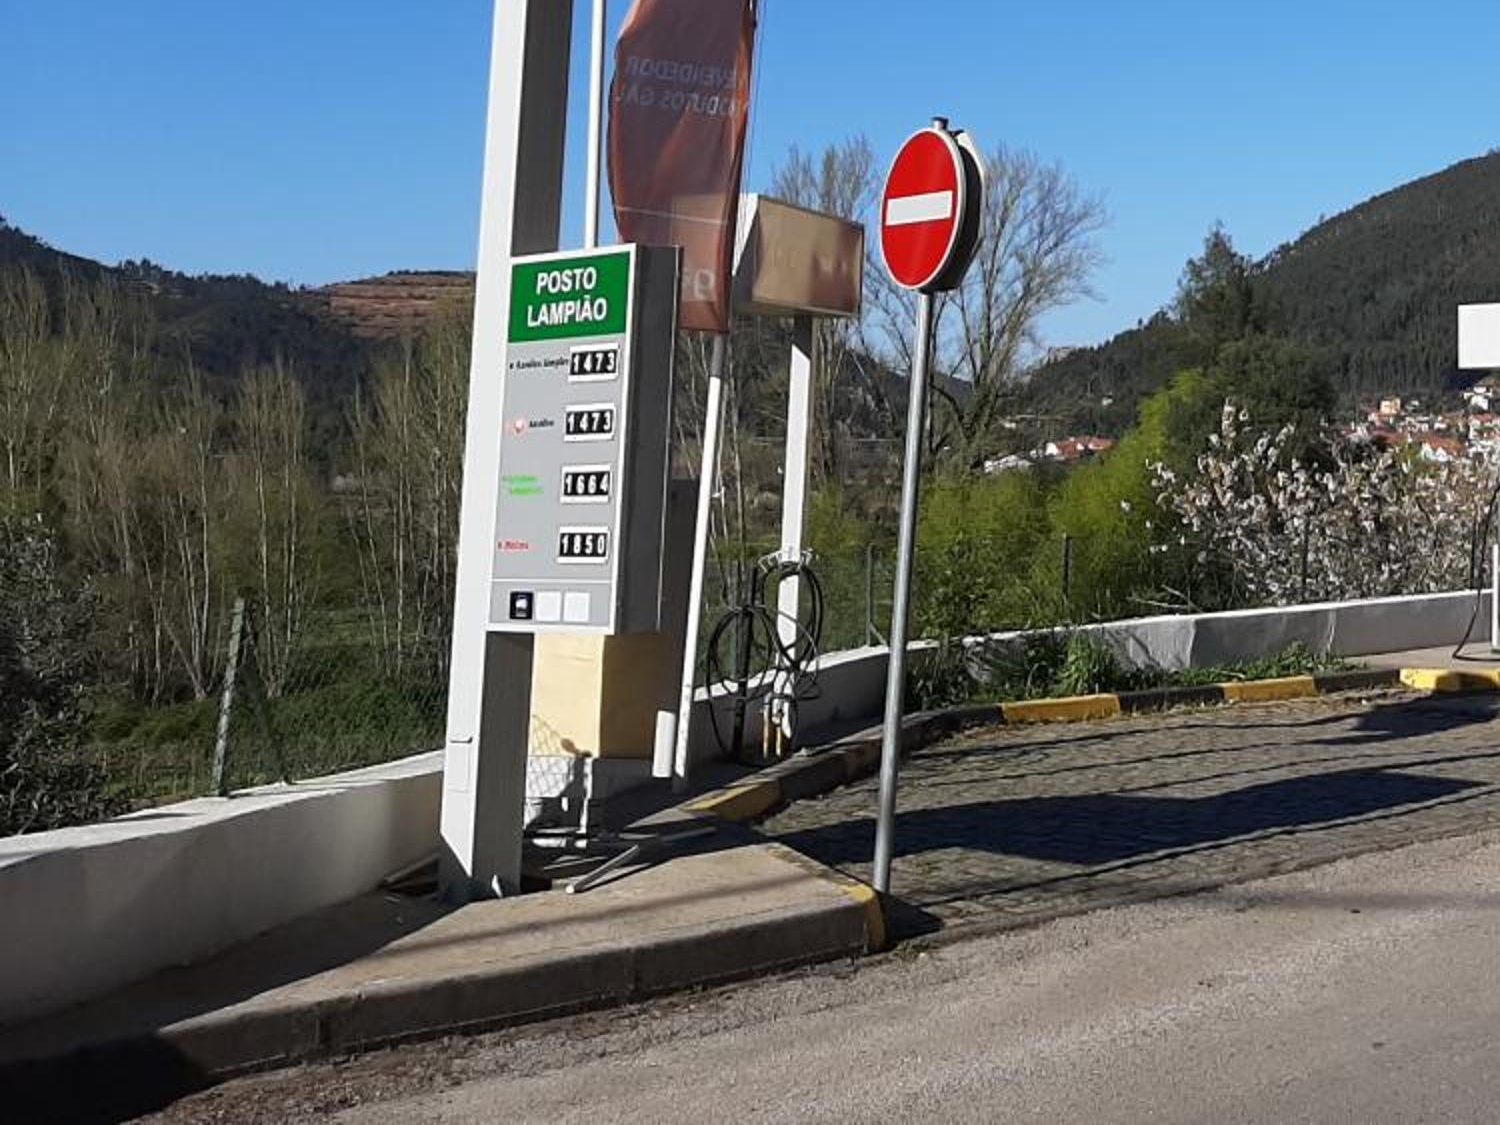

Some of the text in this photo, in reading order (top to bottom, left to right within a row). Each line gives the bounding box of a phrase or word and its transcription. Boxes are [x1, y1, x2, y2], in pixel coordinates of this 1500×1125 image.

[536, 267, 597, 295] POSTO
[527, 295, 607, 327] LAMPIÃO
[573, 352, 615, 373] 1473
[567, 411, 611, 433] 1473
[565, 473, 609, 494] 1664
[561, 534, 605, 555] 1850
